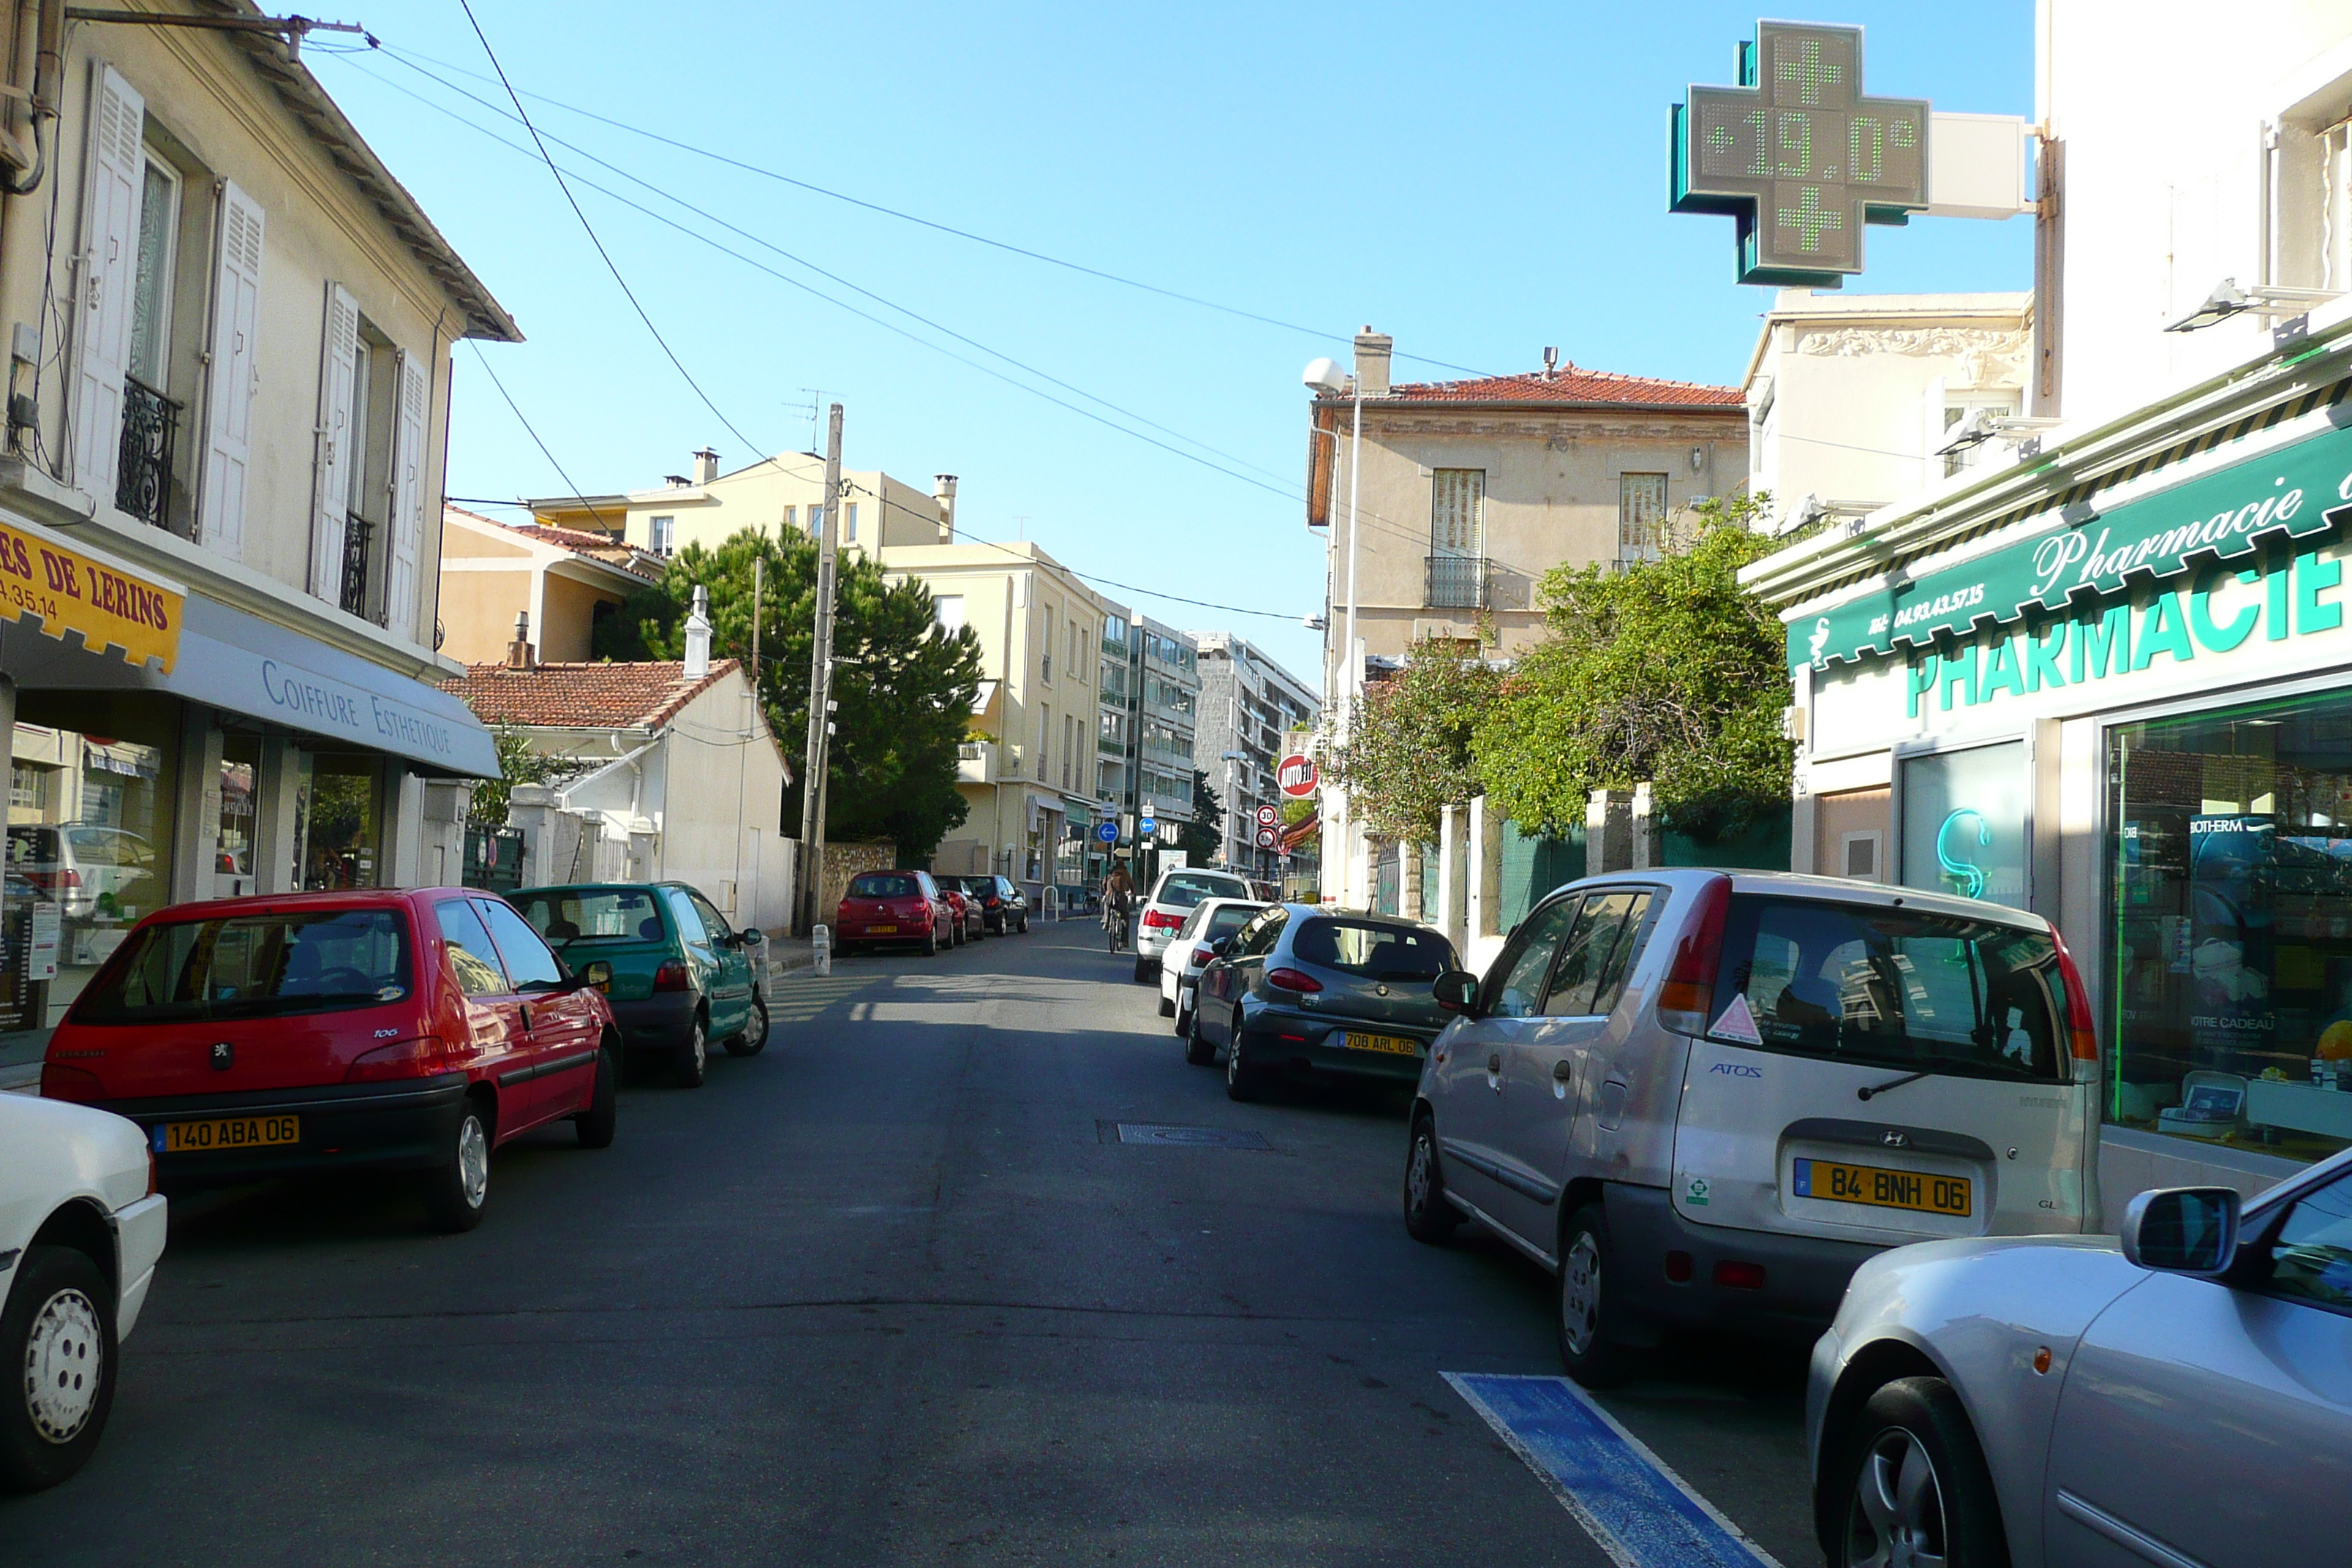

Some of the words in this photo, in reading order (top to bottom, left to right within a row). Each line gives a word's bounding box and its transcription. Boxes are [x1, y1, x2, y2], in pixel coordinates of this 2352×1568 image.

[2029, 476, 2304, 598] Pharmacie
[0, 529, 33, 580] ES
[39, 549, 81, 600] DE
[86, 566, 167, 630] LERINS
[1894, 583, 1985, 628] 04.93.43.57.15
[1907, 553, 2342, 719] PHARMACIE
[1262, 812, 1273, 820] 30
[373, 1028, 399, 1039] 106
[2220, 1017, 2274, 1030] CADEAU
[1346, 1033, 1369, 1047] 708
[1372, 1038, 1394, 1051] ARL
[1398, 1041, 1414, 1053] 06
[1709, 1063, 1763, 1078] ATOS
[172, 1123, 212, 1147] 140
[218, 1120, 260, 1145] ABA
[265, 1117, 295, 1141] 06
[1831, 1168, 1862, 1197] 84
[1874, 1173, 1921, 1205] BNH
[1934, 1181, 1964, 1210] 06
[2038, 1199, 2057, 1210] GL
